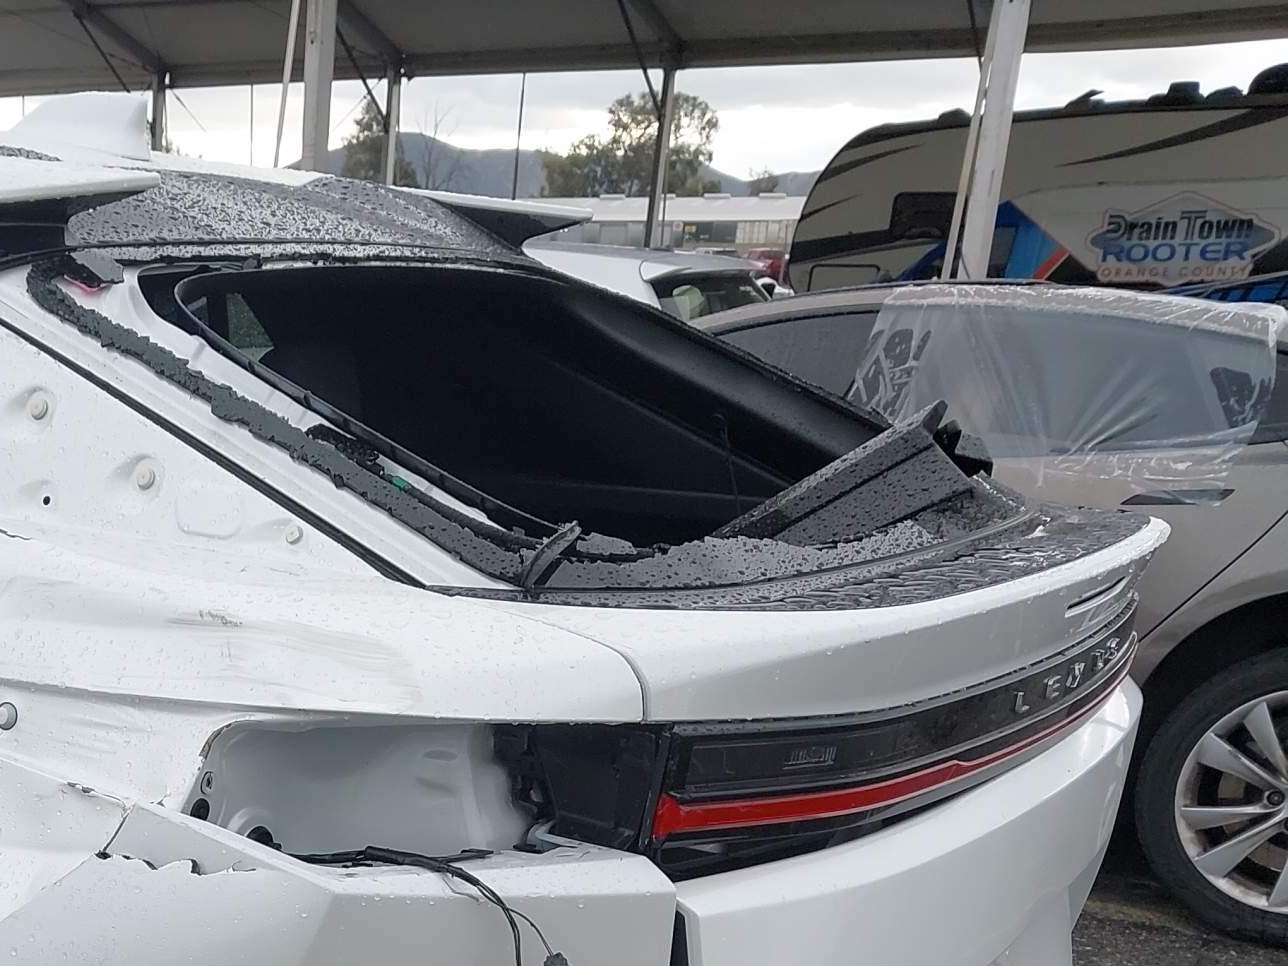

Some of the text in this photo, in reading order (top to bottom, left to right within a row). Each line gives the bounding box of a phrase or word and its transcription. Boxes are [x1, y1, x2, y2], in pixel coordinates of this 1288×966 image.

[1179, 210, 1253, 240] Town
[1101, 241, 1247, 263] ROOTER
[1100, 265, 1247, 280] ORANGE COUNTY
[1014, 637, 1120, 713] LEXUS
